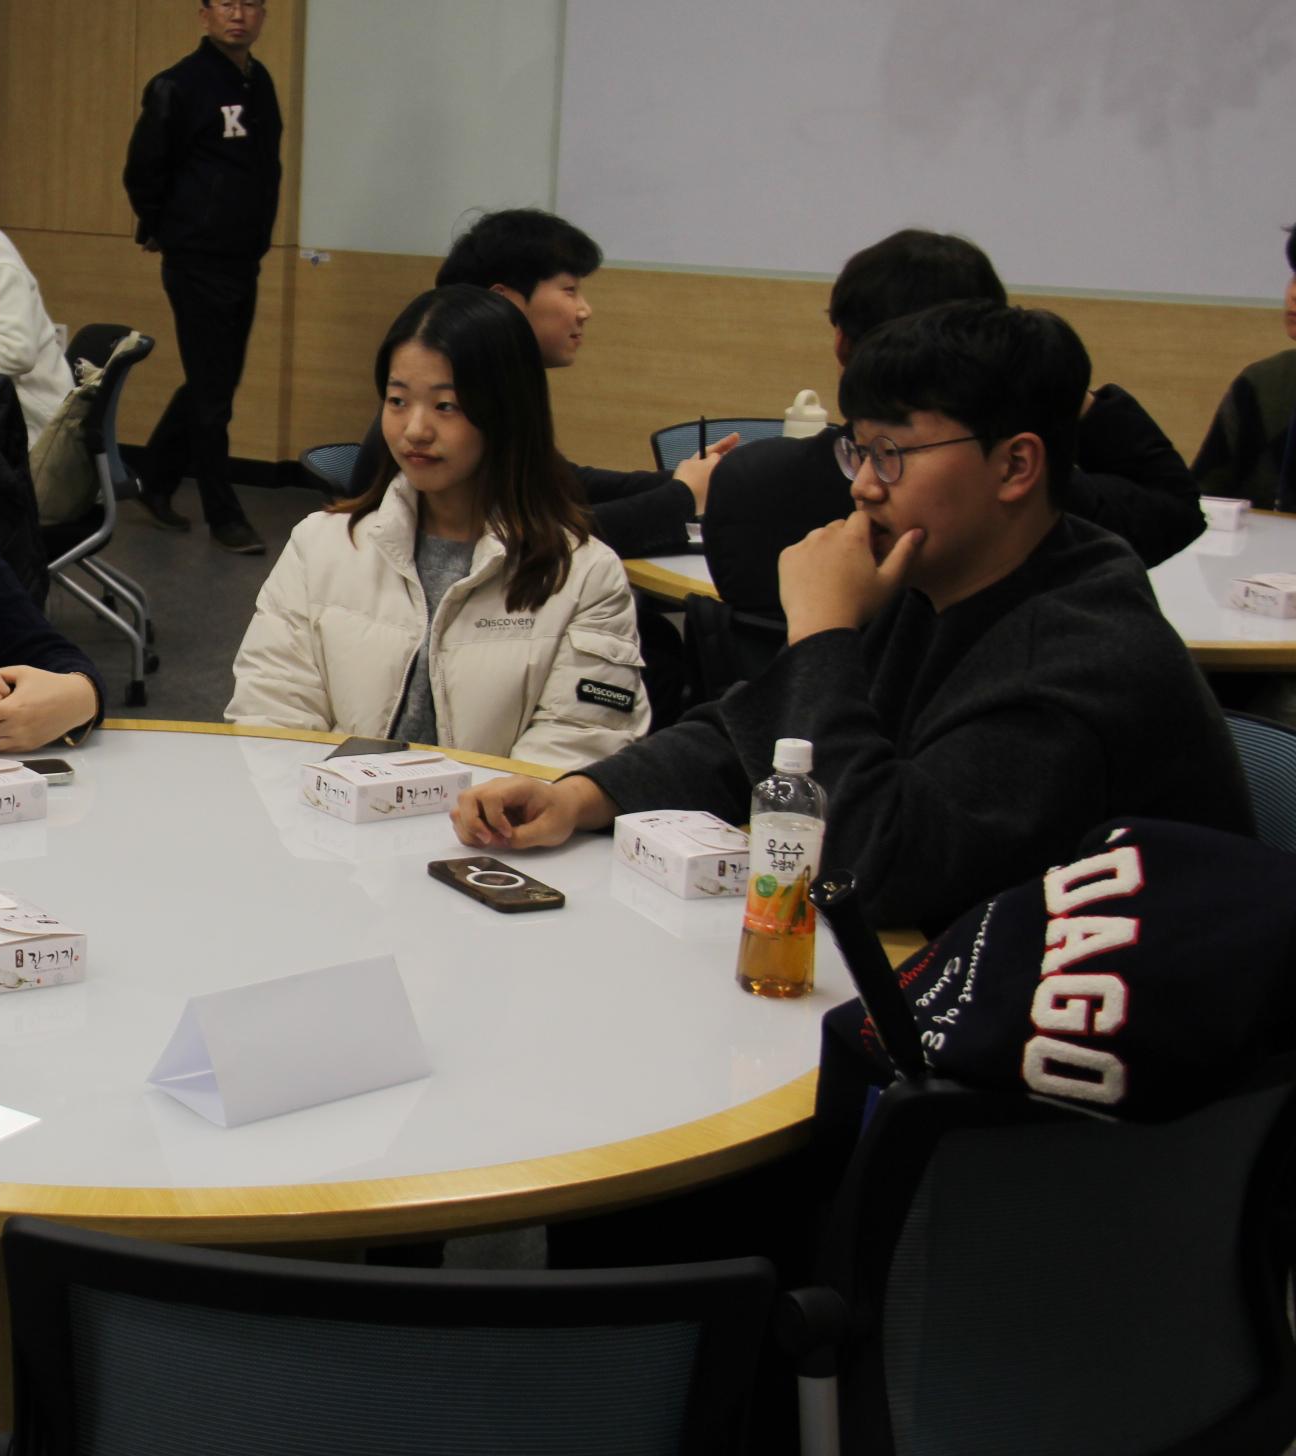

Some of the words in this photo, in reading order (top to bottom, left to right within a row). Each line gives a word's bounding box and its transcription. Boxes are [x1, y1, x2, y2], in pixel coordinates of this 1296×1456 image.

[220, 104, 247, 138] K
[475, 617, 535, 629] Discovery
[582, 683, 631, 705] Discovery
[765, 838, 805, 860] 옥수수
[1021, 828, 1146, 1105] DAGO
